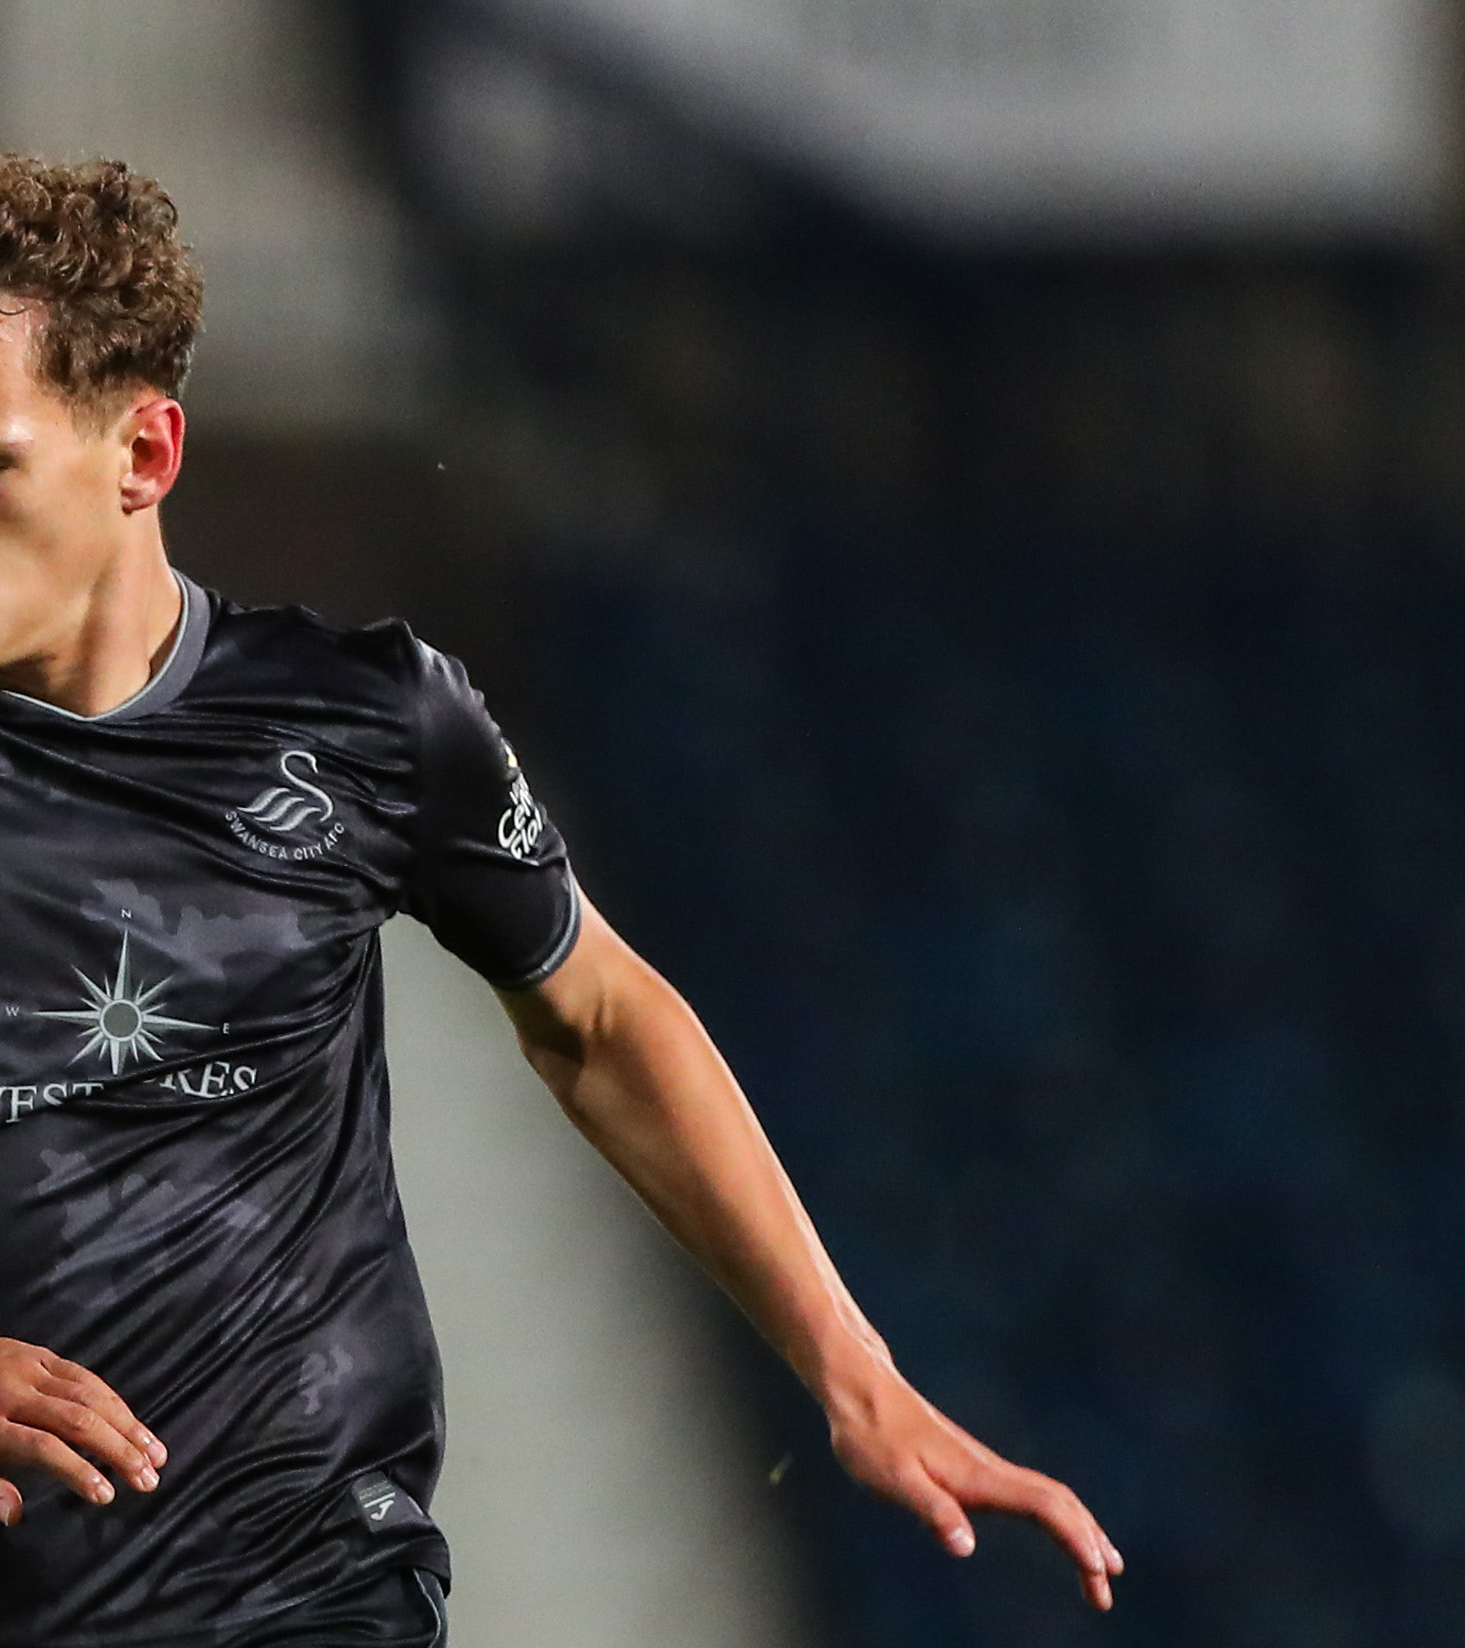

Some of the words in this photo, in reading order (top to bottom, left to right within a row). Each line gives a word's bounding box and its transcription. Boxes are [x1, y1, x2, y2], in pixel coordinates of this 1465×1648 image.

[225, 811, 288, 860] SWANSEA
[294, 843, 323, 860] CITY
[324, 822, 345, 850] AFC
